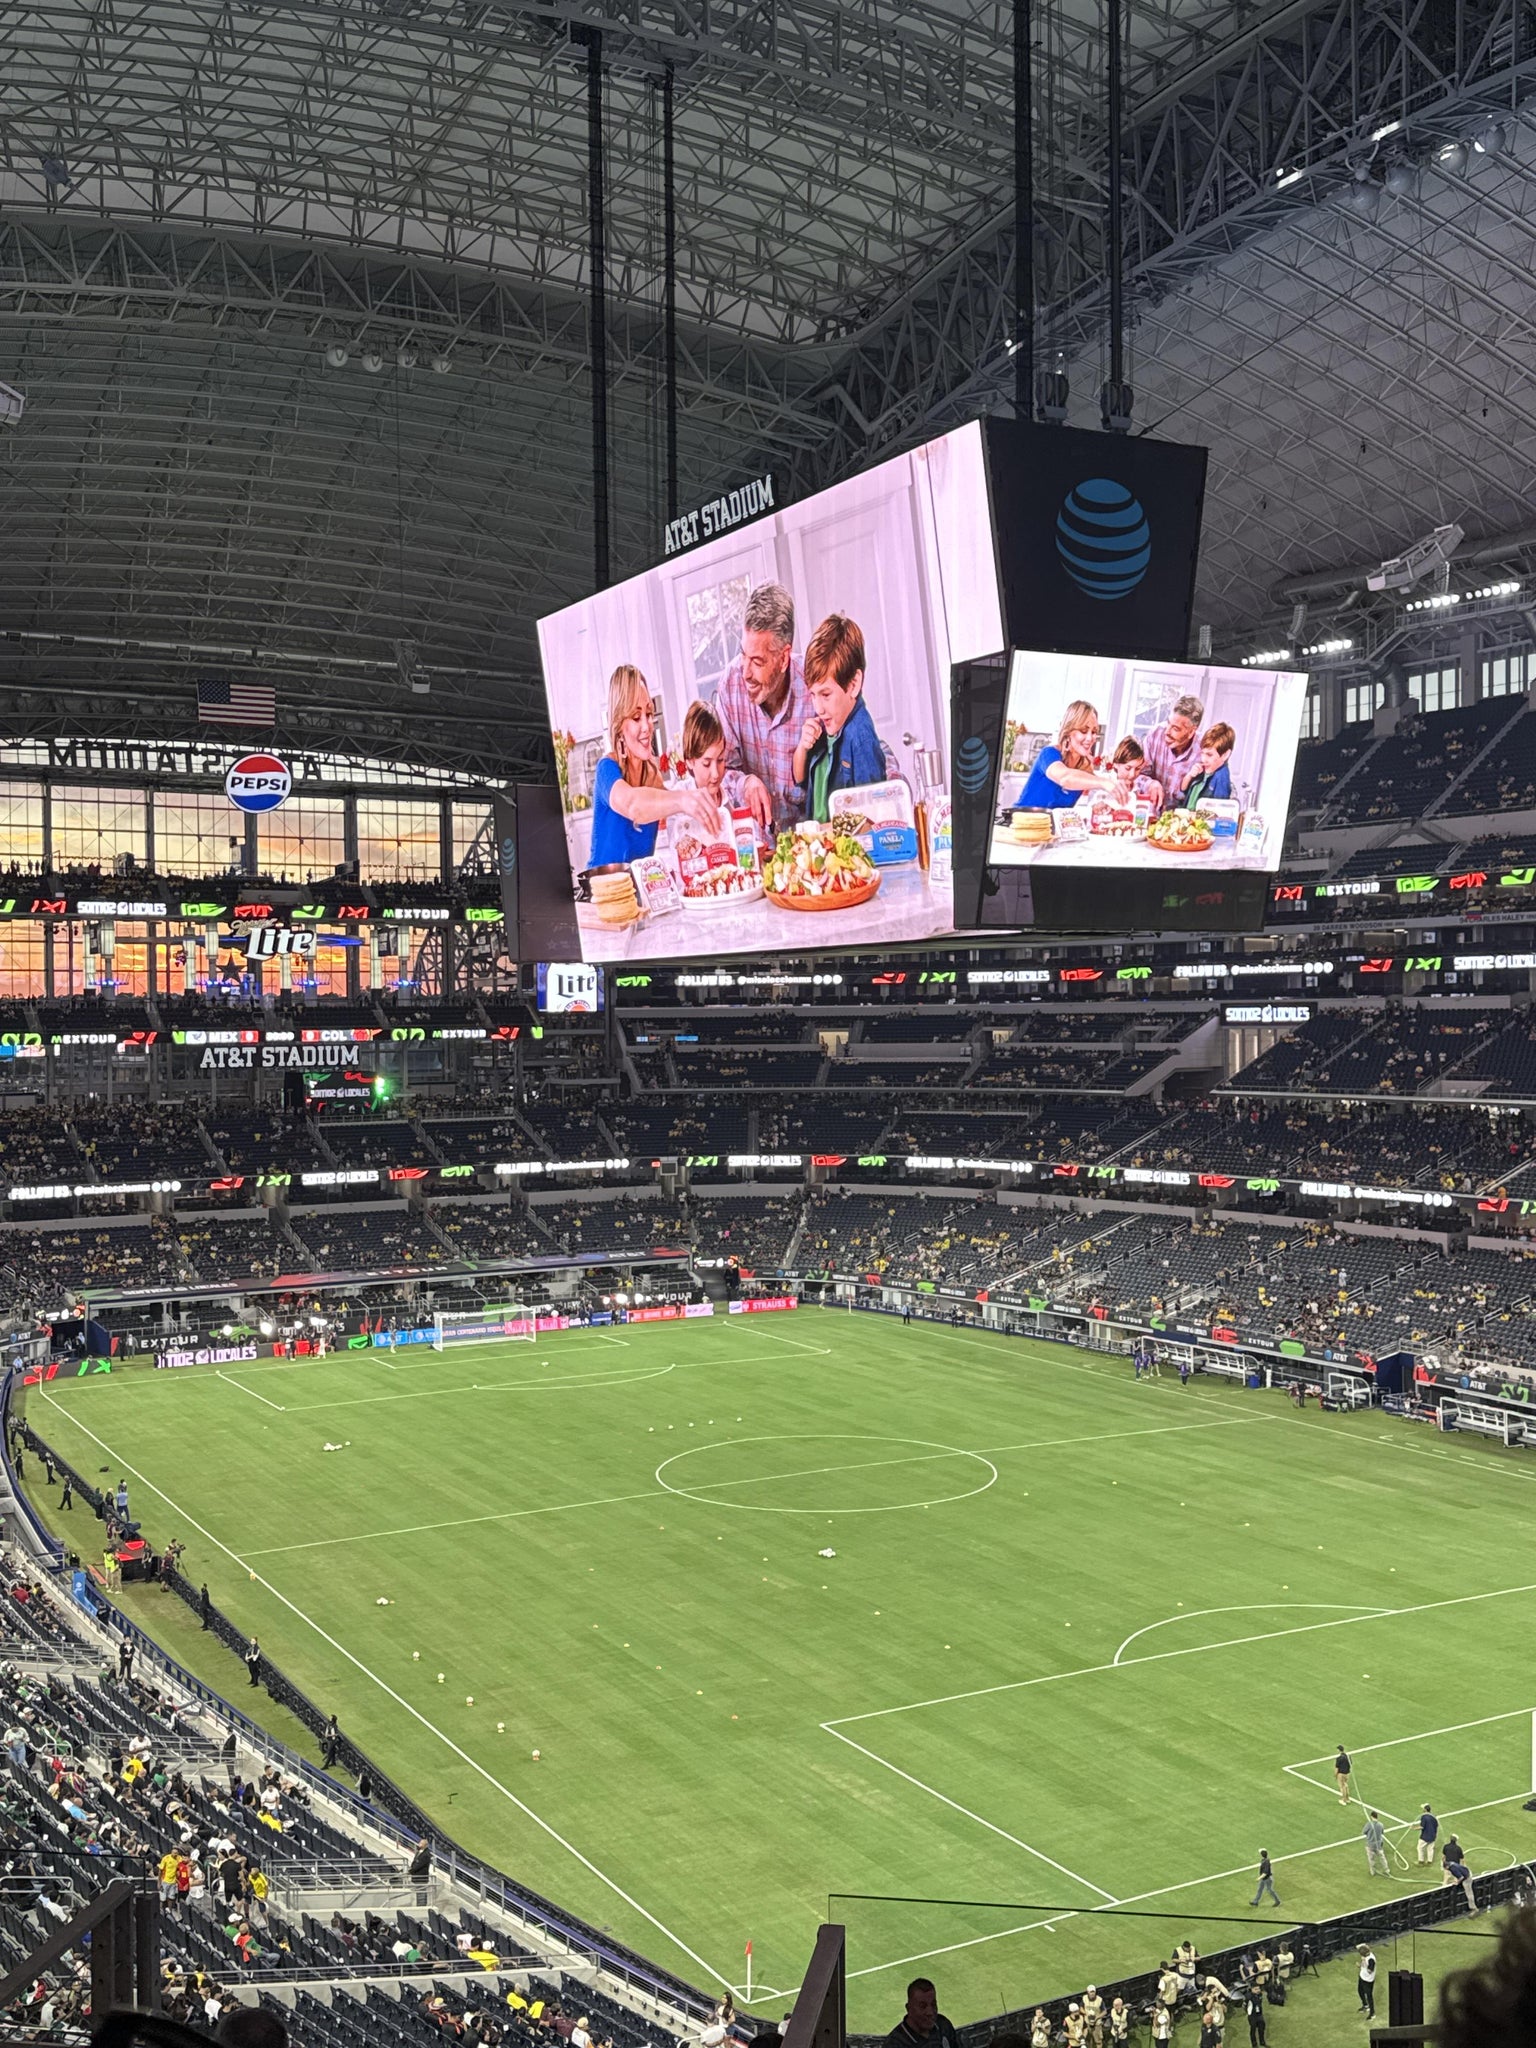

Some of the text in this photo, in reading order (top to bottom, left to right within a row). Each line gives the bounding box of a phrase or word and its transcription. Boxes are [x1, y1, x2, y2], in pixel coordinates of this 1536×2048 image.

[664, 474, 775, 555] AT&T STADIUM
[230, 776, 288, 791] PEPSI
[1315, 881, 1380, 897] MEXTOUR
[382, 908, 450, 920] MEXTOUR
[243, 927, 315, 960] Lite
[557, 974, 595, 998] Lite
[51, 1034, 117, 1044] MEXTOUR
[208, 1031, 238, 1043] MEX
[321, 1030, 347, 1041] COL
[432, 1029, 487, 1039] MEXTOUR
[200, 1045, 360, 1068] AT&T STADIUM
[753, 1299, 787, 1310] STRAUSS
[211, 1345, 257, 1364] LOCALES
[1332, 1353, 1348, 1362] AT&T
[1469, 1381, 1487, 1391] AT&T
